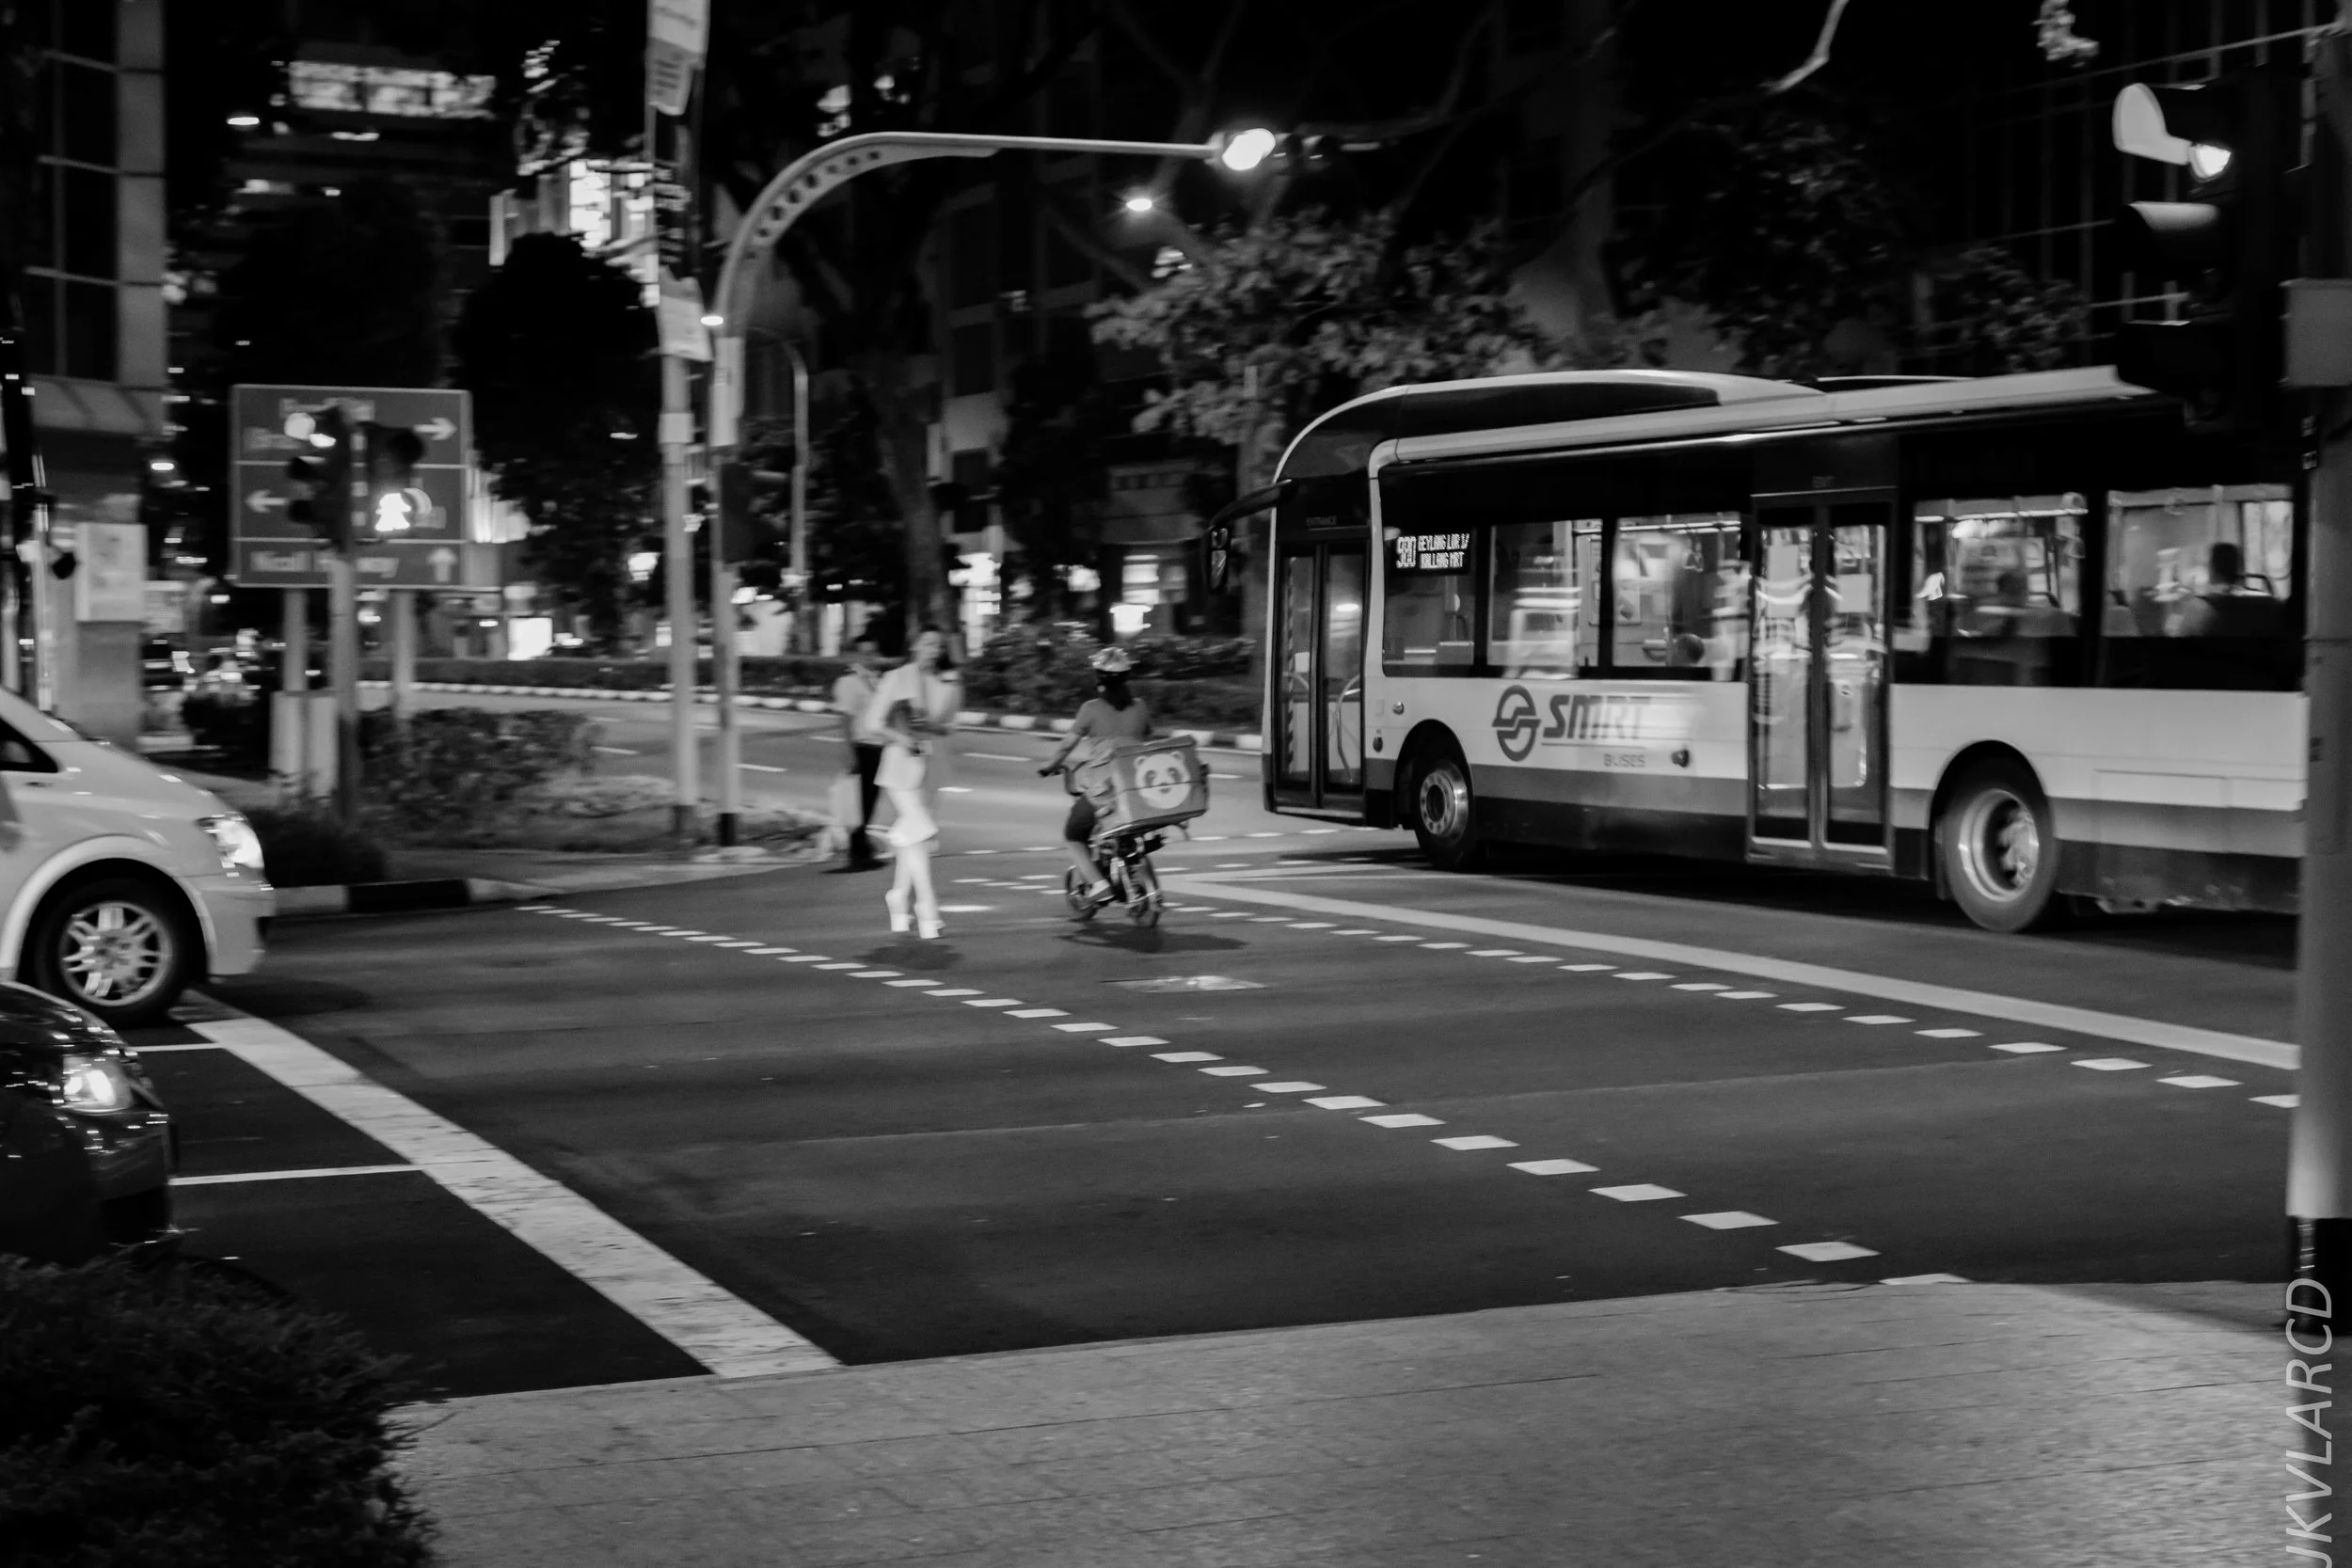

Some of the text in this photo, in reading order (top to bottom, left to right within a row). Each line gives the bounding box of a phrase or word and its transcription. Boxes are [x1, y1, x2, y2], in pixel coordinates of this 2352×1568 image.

[1306, 515, 1337, 527] ENTRANCE
[1543, 694, 1651, 739] SMRT
[1603, 752, 1645, 768] BUSES
